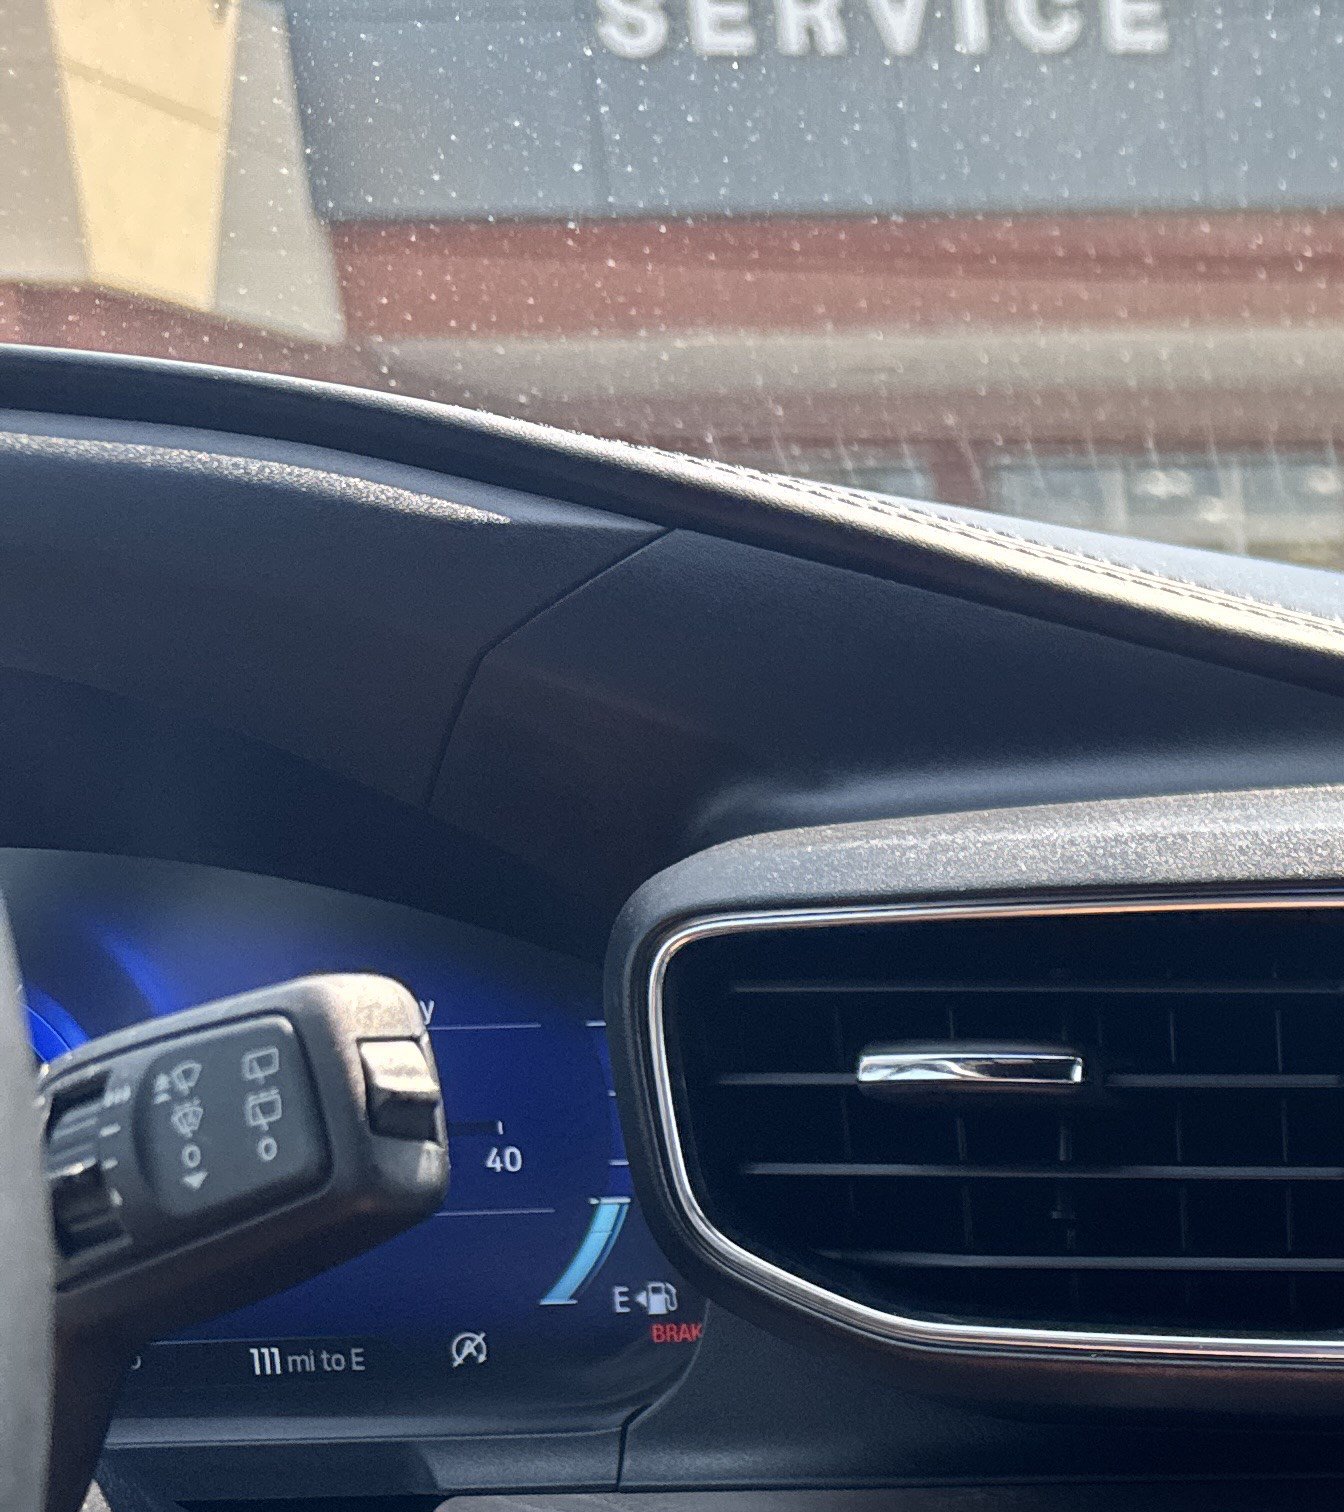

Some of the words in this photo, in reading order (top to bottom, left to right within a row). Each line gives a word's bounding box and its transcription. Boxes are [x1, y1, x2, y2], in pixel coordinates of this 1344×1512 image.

[599, 0, 1171, 58] SERVICE
[485, 1145, 523, 1173] 40
[613, 1286, 631, 1313] E
[249, 1346, 282, 1376] 111
[287, 1349, 316, 1373] mi
[320, 1350, 346, 1372] to
[350, 1347, 366, 1371] E
